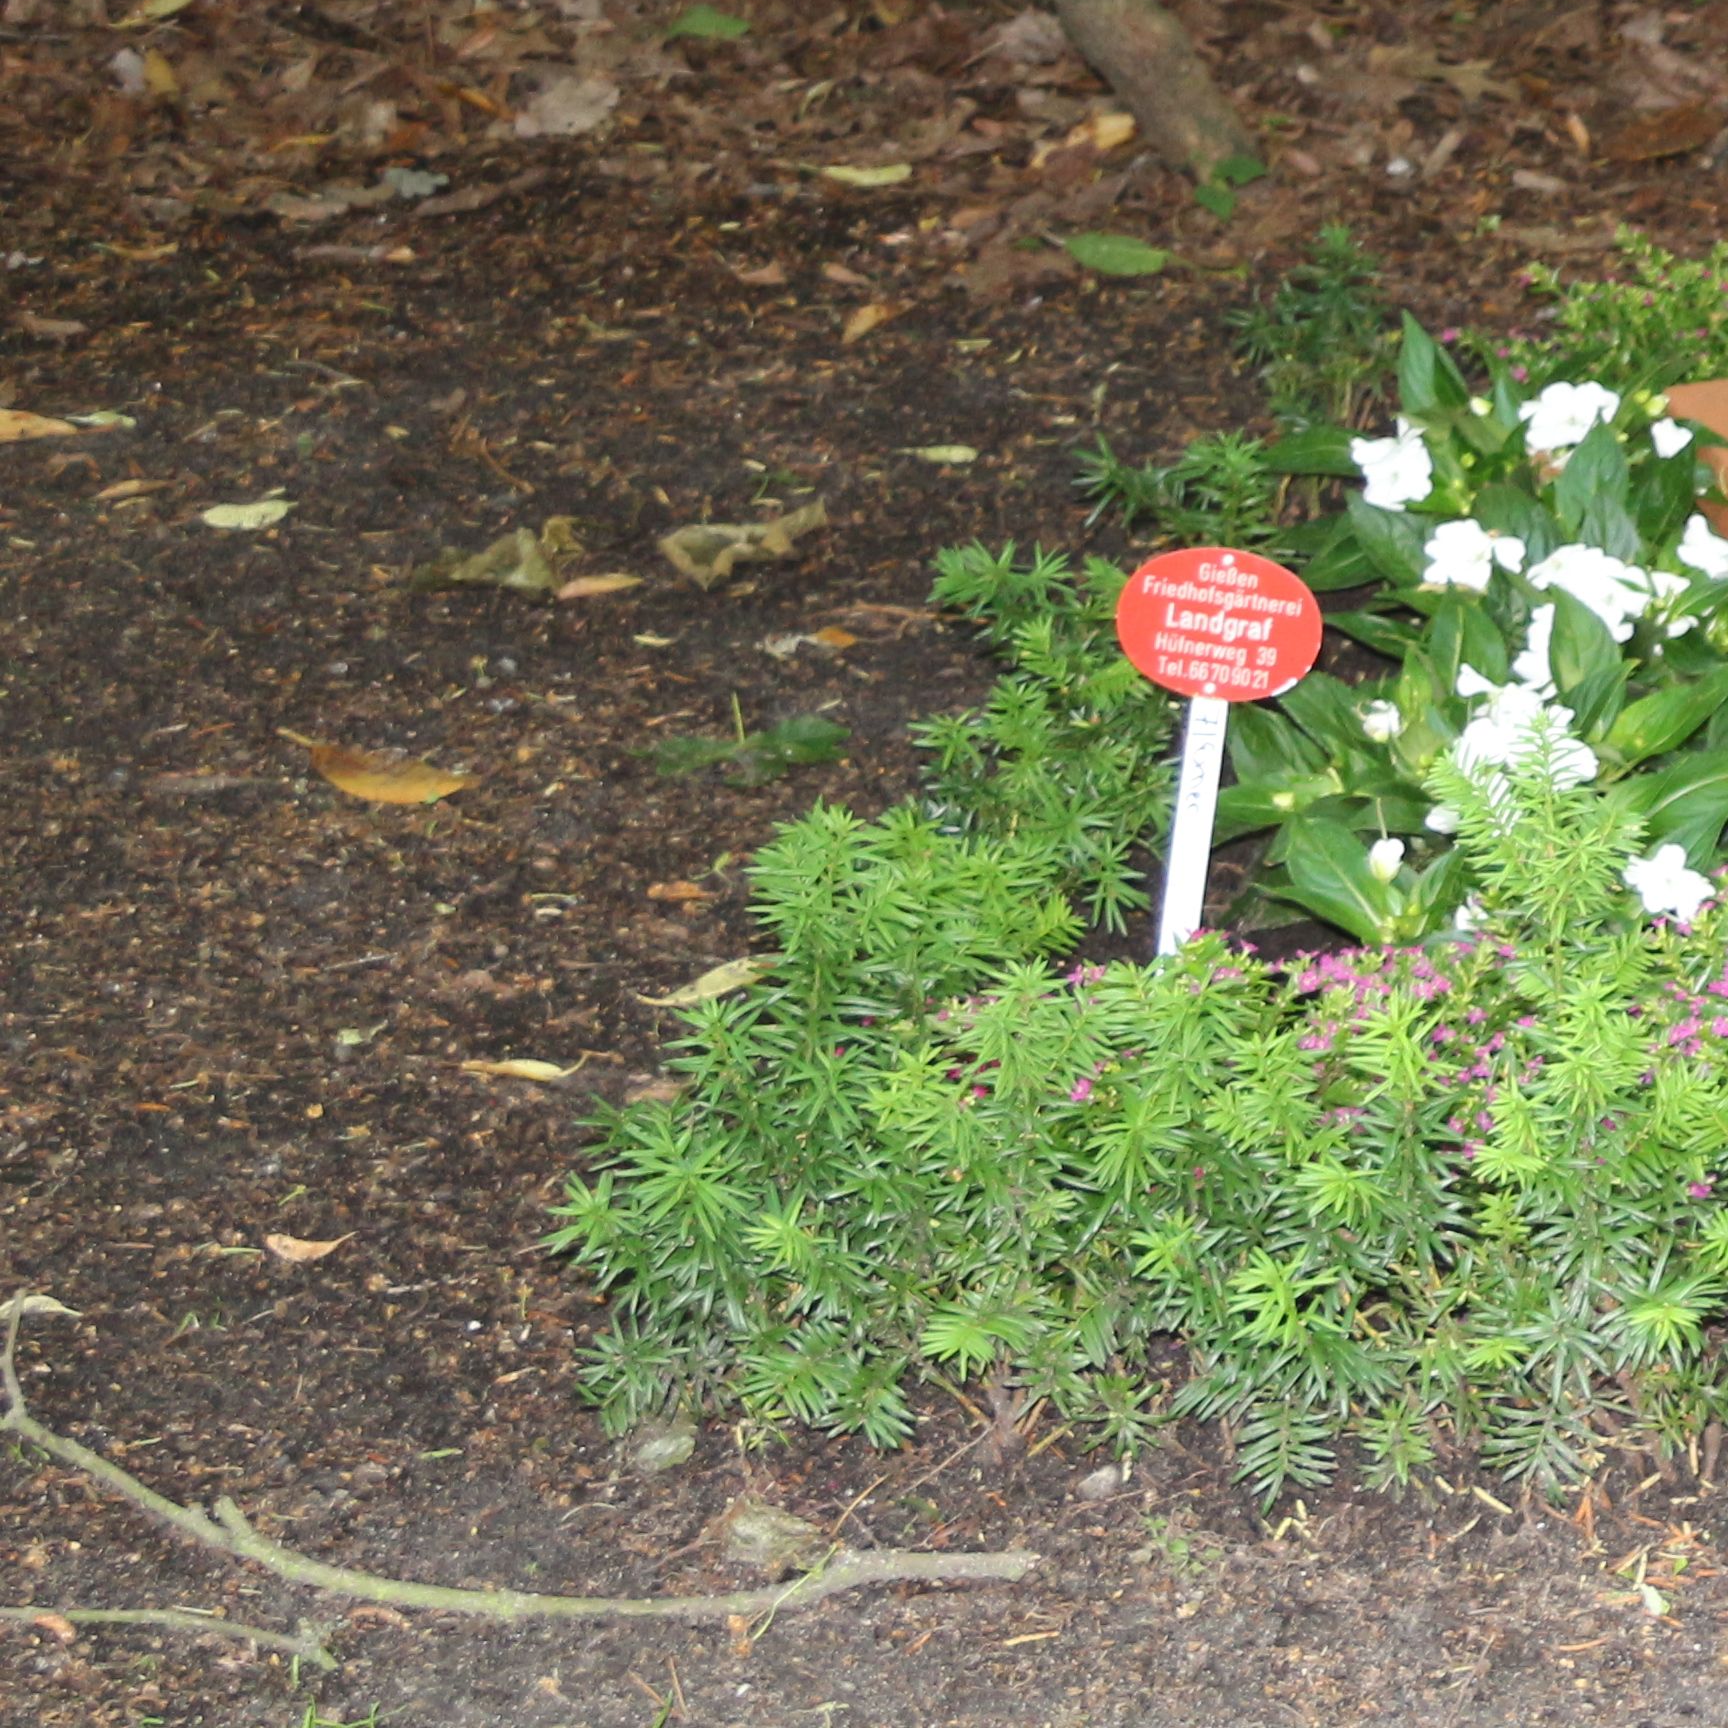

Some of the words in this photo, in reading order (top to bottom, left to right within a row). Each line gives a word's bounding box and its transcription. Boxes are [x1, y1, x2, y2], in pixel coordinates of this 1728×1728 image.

[1142, 574, 1304, 617] Friedhofsgärtnerei
[1165, 602, 1274, 642] Landgraf
[1154, 631, 1248, 667] Hüfnerweg
[1256, 646, 1278, 667] 39
